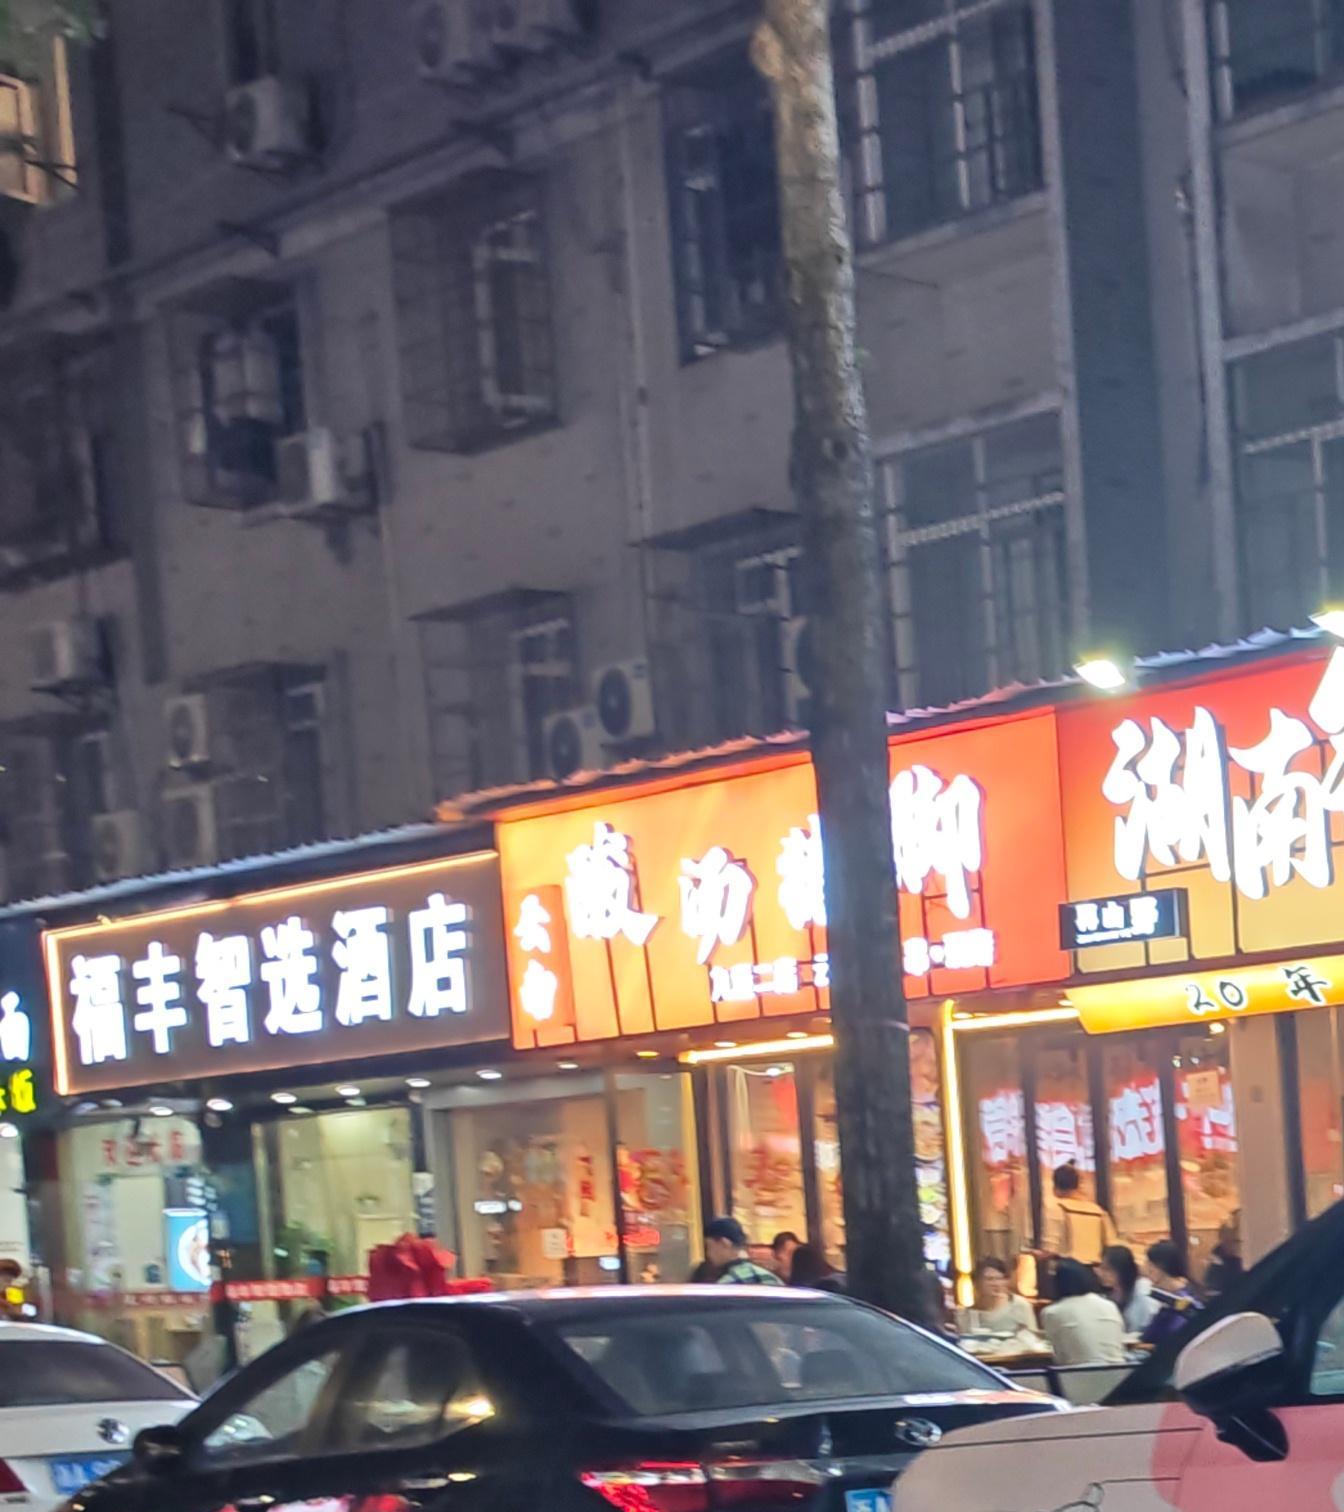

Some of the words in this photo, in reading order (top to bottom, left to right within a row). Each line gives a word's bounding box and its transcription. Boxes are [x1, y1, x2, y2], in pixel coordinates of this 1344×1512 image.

[69, 891, 471, 1066] 福丰智选酒店
